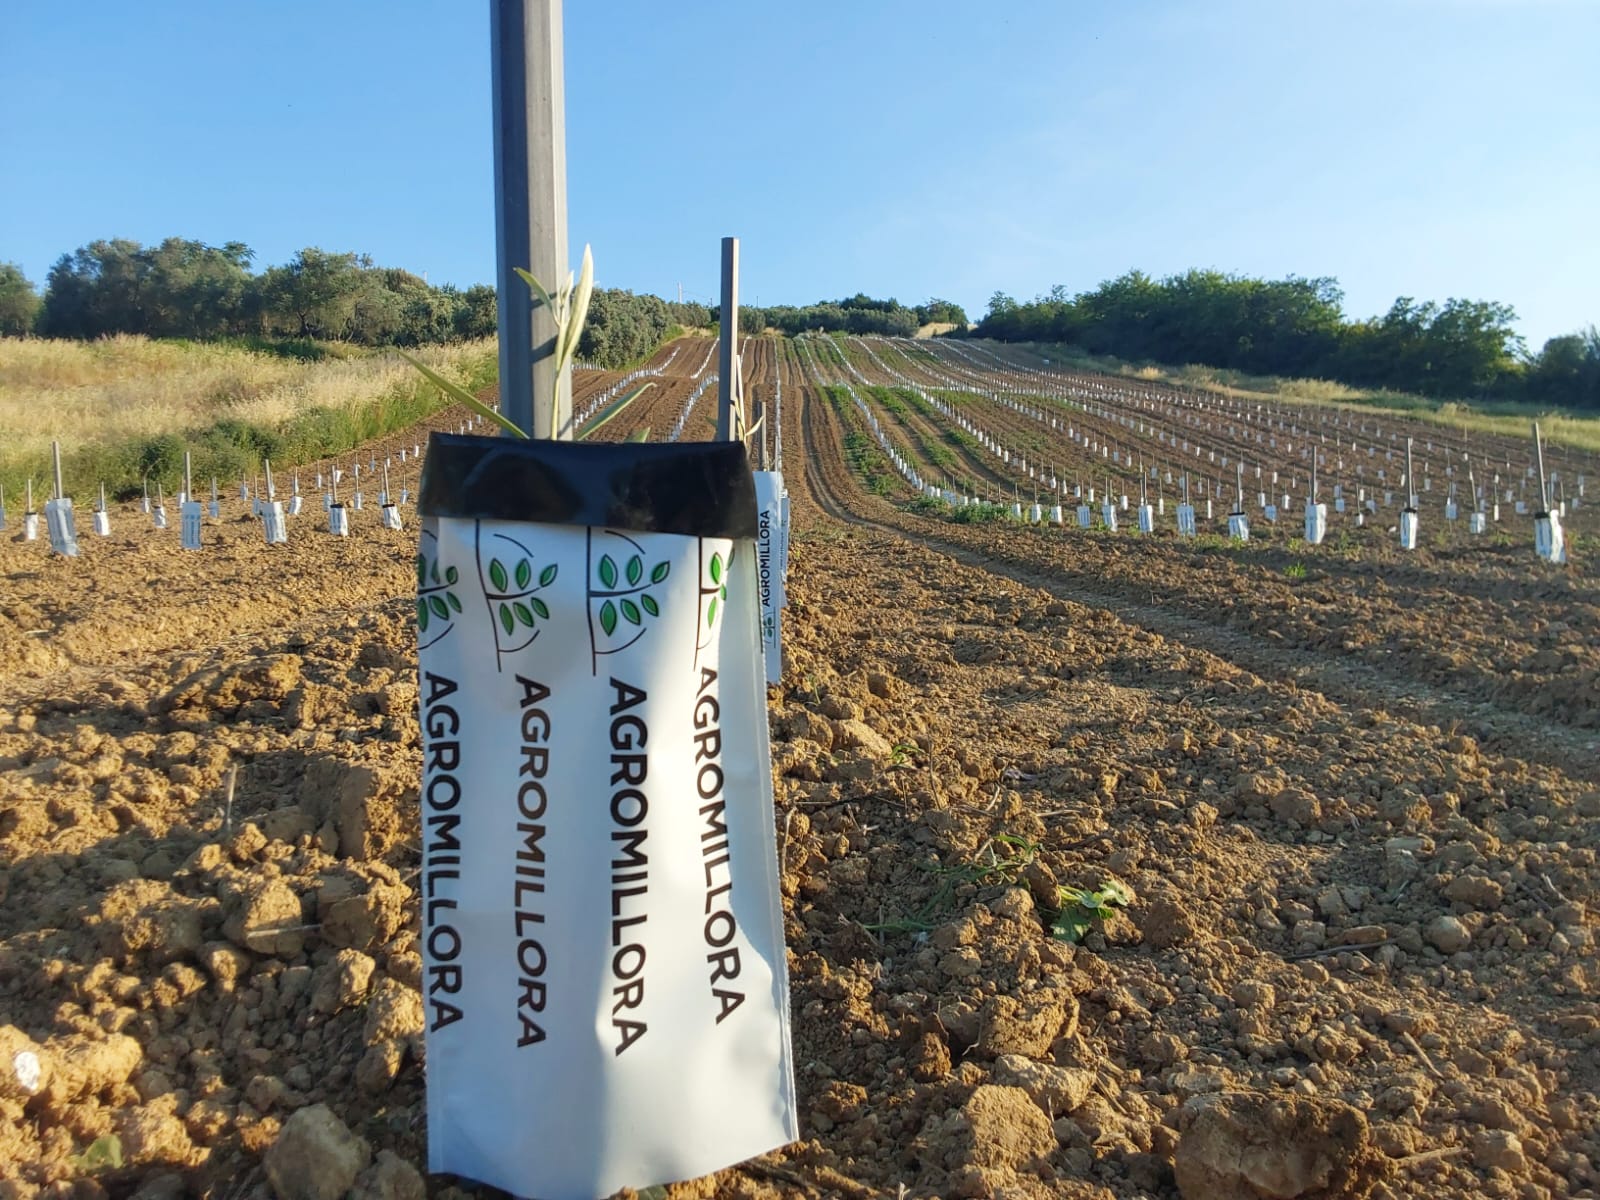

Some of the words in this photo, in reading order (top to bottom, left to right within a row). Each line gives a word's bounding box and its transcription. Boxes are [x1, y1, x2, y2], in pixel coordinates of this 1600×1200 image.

[759, 510, 770, 607] AGROMILLORA
[425, 671, 464, 1033] AGROMILLORA
[514, 673, 551, 1048] AGROMILLORA
[609, 676, 648, 1057] AGROMILLORA
[693, 666, 746, 1025] AGROMILLORA
